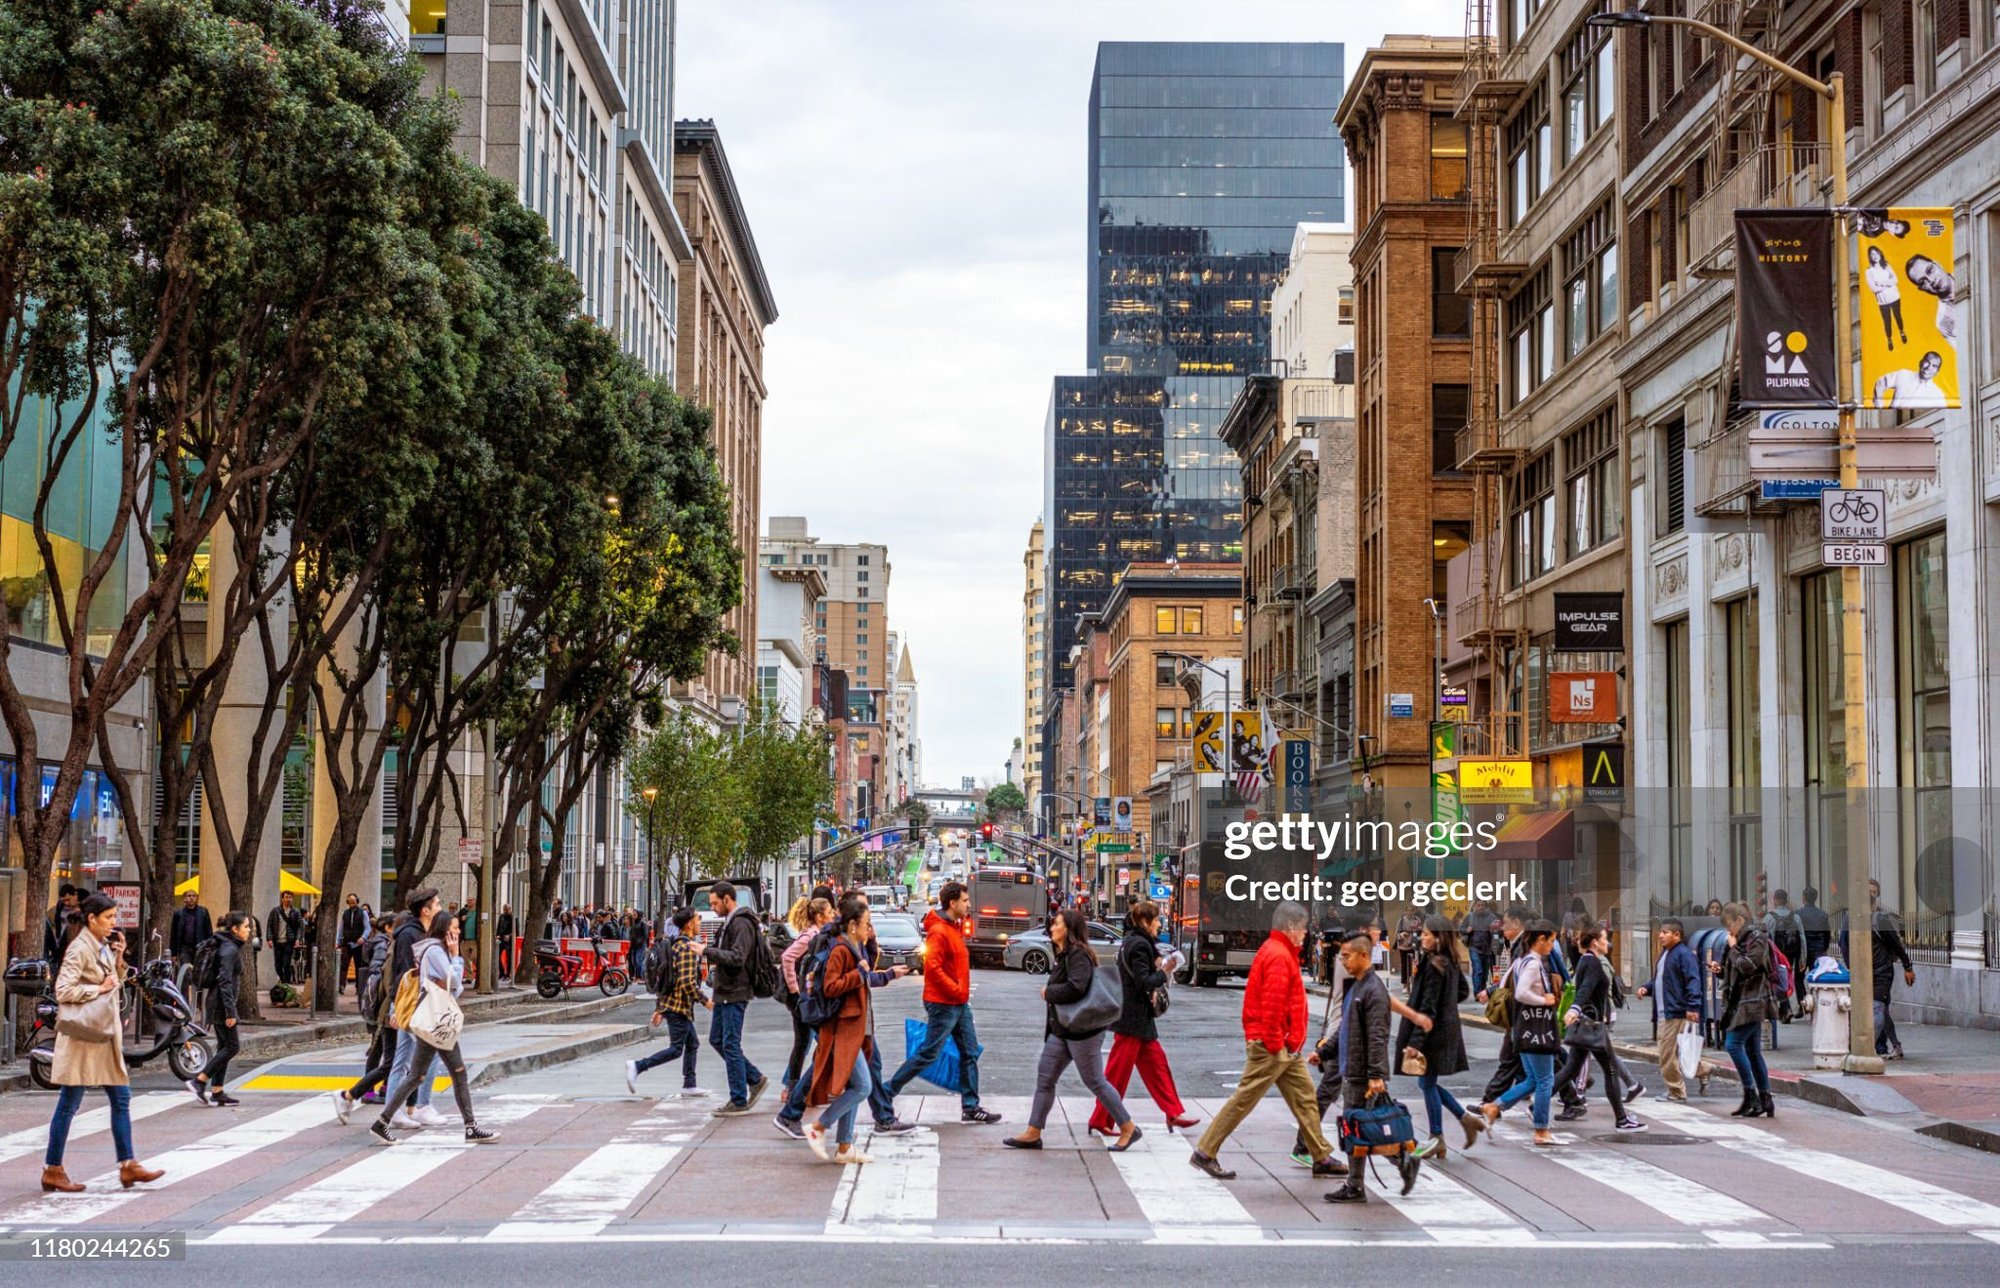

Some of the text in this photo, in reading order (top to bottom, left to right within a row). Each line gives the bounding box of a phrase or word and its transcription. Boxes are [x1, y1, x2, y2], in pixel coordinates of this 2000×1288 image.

[1759, 254, 1808, 262] HISTORY
[1766, 378, 1810, 388] PILIPINAS
[1781, 421, 1839, 429] COLTON
[1831, 526, 1878, 537] BIKE LANE
[1833, 548, 1875, 561] BEGIN
[1559, 612, 1619, 622] IMPULSE
[1570, 622, 1608, 632] GEAR
[1574, 694, 1592, 706] Ns
[1292, 742, 1305, 811] BOOKS
[1207, 877, 1225, 893] ups
[115, 889, 140, 898] PARKING
[1521, 1007, 1553, 1021] BIEN
[1521, 1030, 1555, 1045] FAIT
